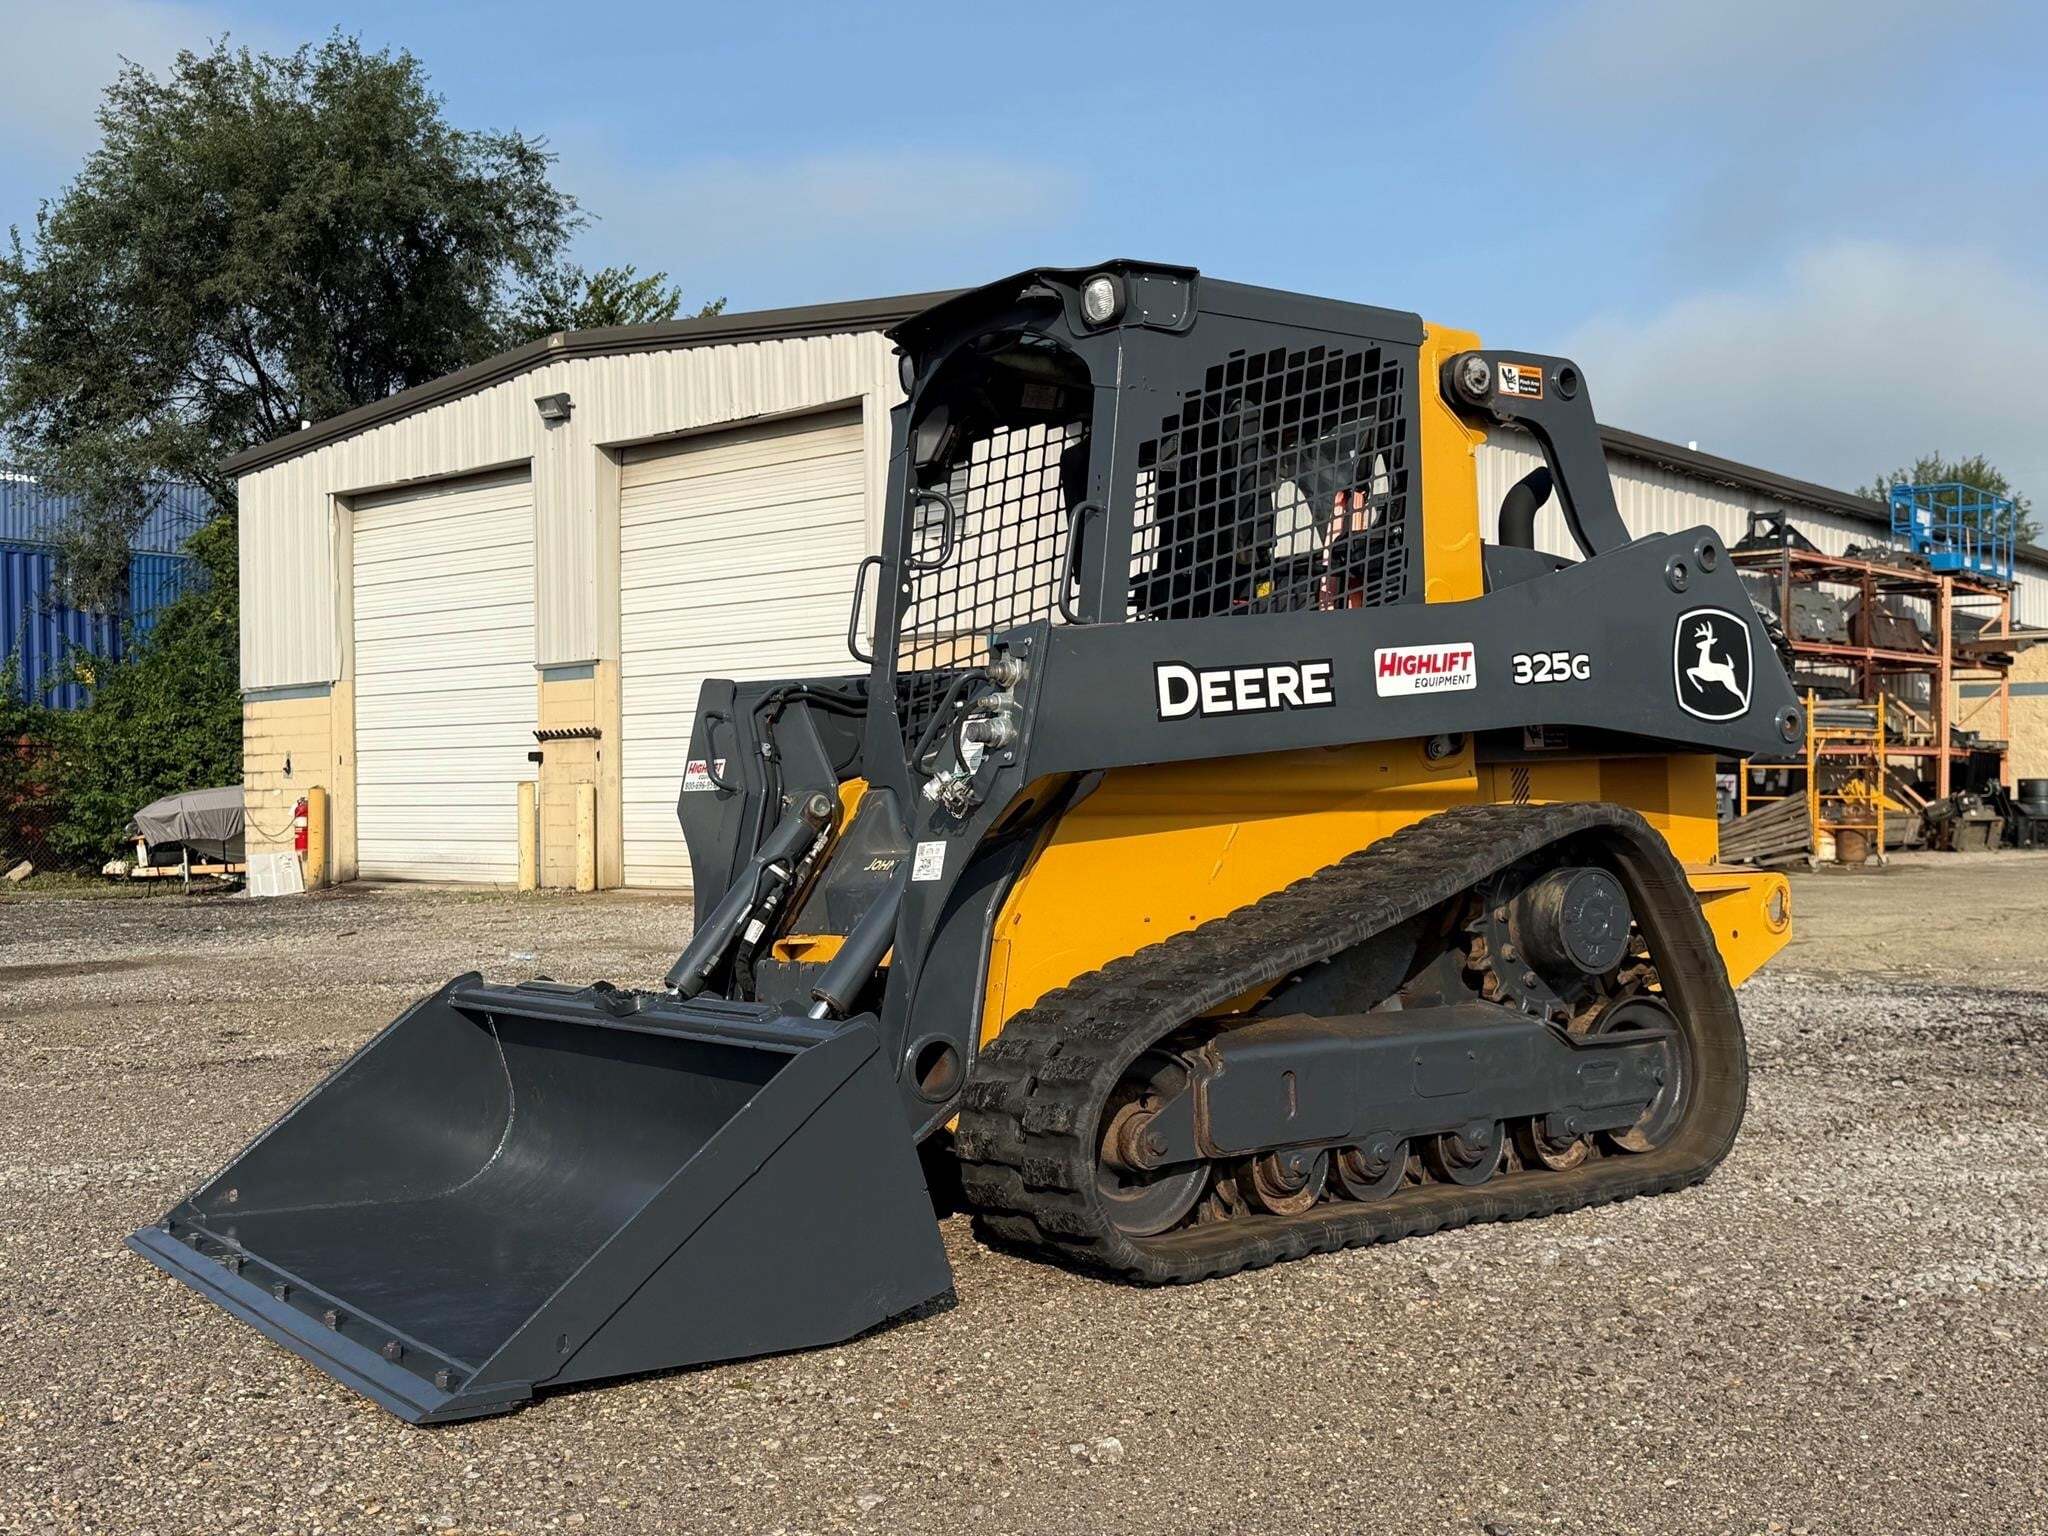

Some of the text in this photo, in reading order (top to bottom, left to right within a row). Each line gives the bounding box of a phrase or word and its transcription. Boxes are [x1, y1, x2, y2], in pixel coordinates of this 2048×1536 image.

[1378, 651, 1473, 678] HIGHLIFT
[1511, 650, 1592, 685] 325G
[1156, 661, 1333, 718] DEERE
[1414, 673, 1472, 689] EQUIPMENT
